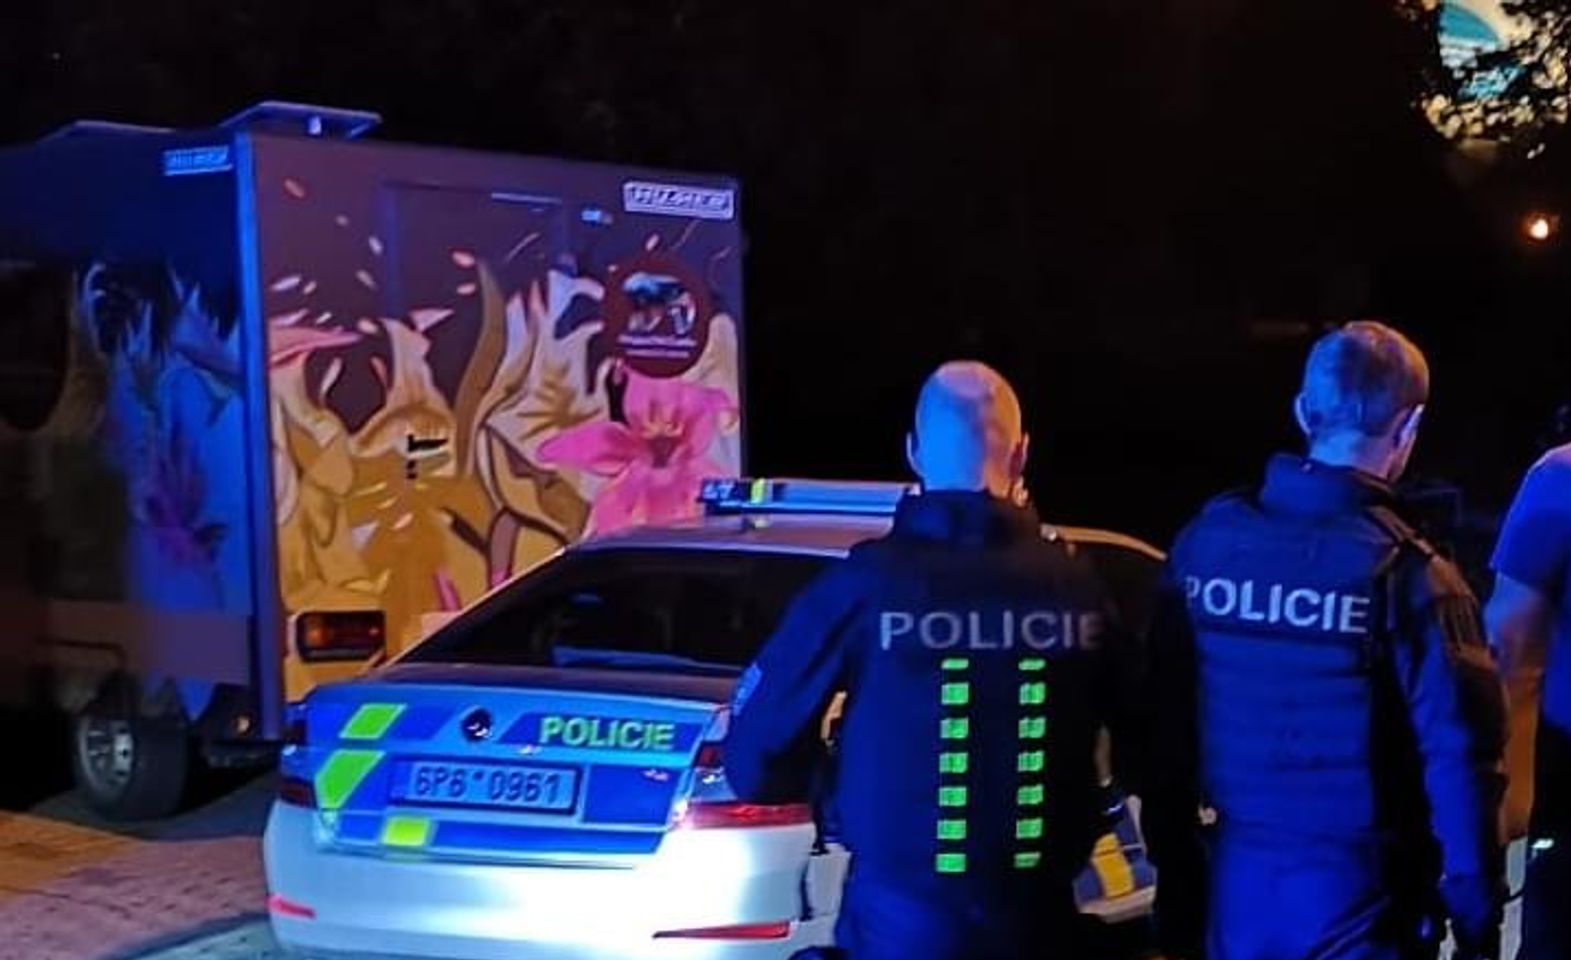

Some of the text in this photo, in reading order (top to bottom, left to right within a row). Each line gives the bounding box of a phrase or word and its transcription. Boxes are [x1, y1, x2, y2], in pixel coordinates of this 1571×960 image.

[1184, 574, 1371, 634] POLICIE
[880, 610, 1102, 651] POLICIE
[539, 715, 675, 750] POLICIE
